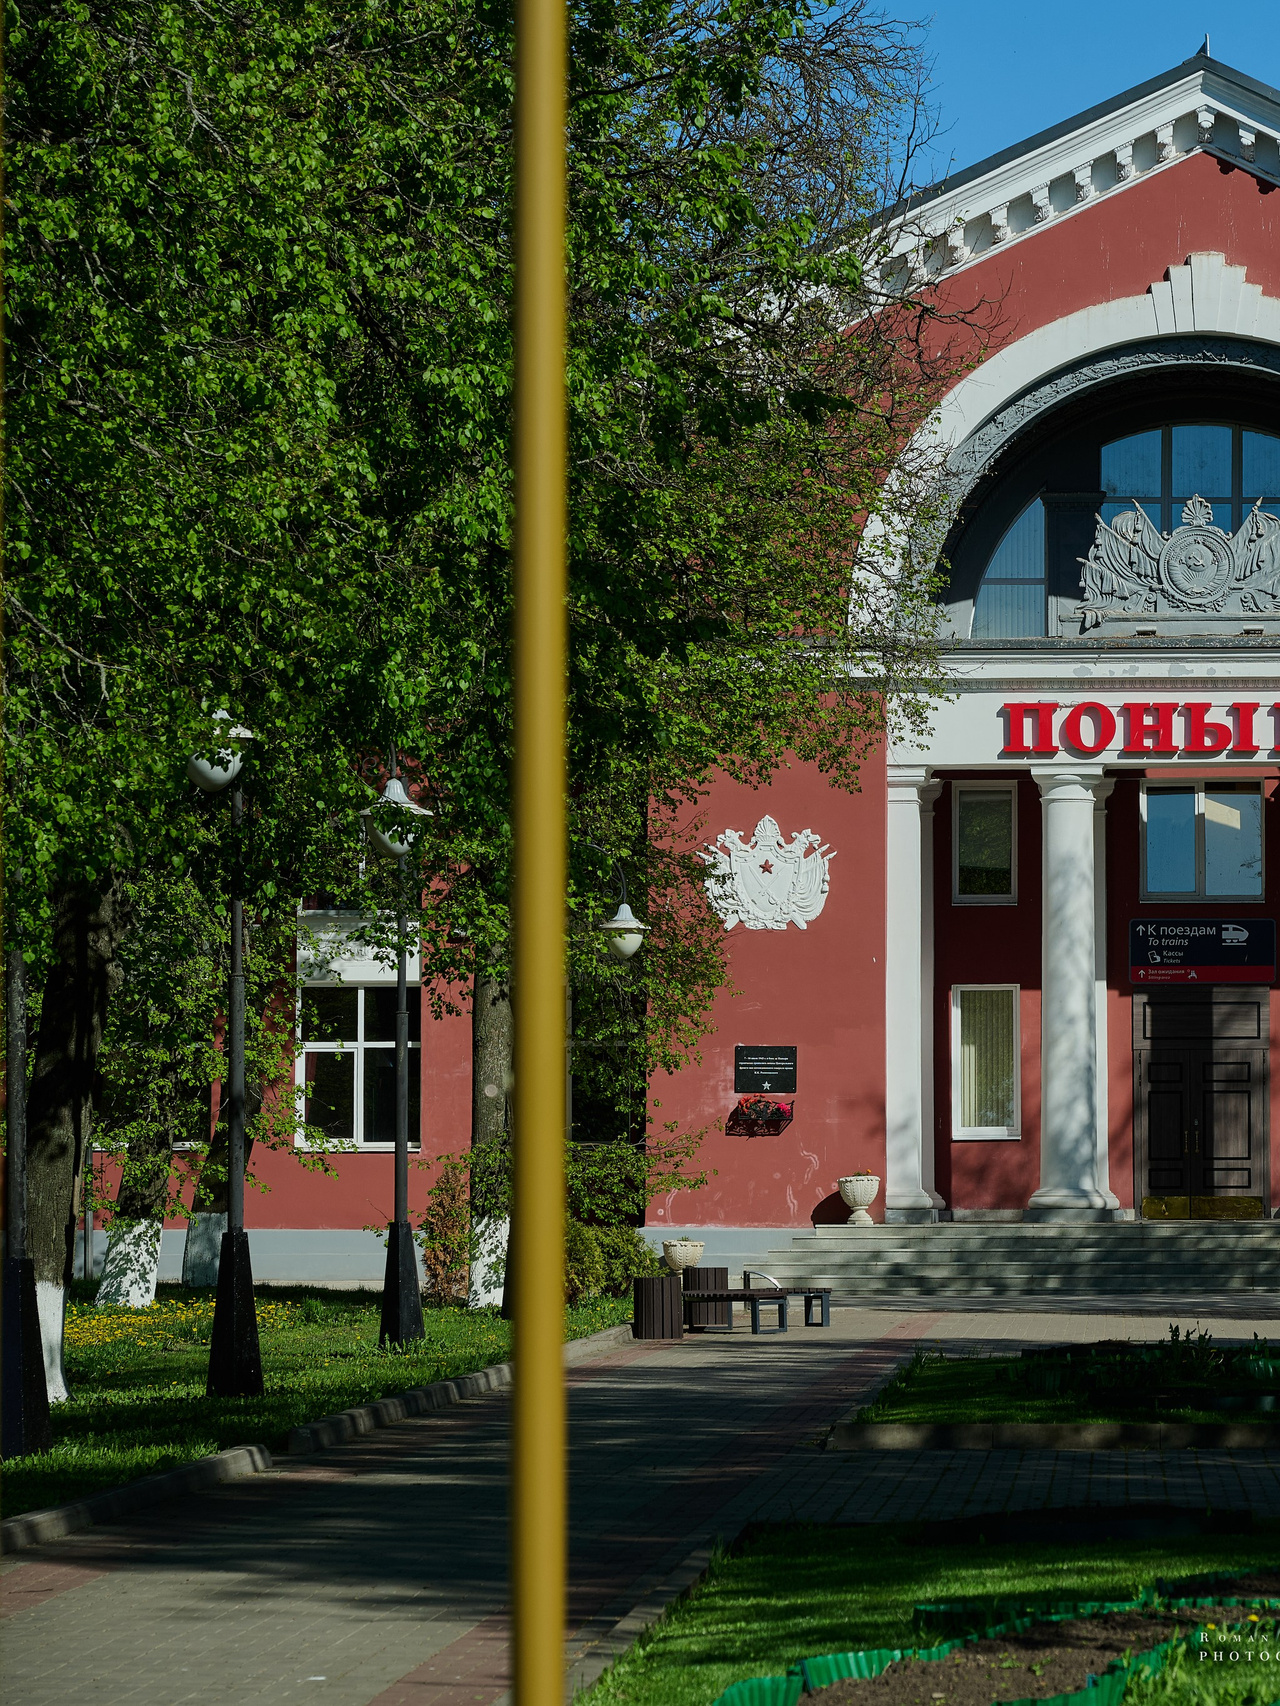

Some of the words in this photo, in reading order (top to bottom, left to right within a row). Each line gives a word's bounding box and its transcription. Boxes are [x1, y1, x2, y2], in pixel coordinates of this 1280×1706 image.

[1148, 924, 1156, 935] К
[1160, 926, 1216, 937] поездам
[1148, 937, 1159, 946] To
[1161, 937, 1189, 946] trains
